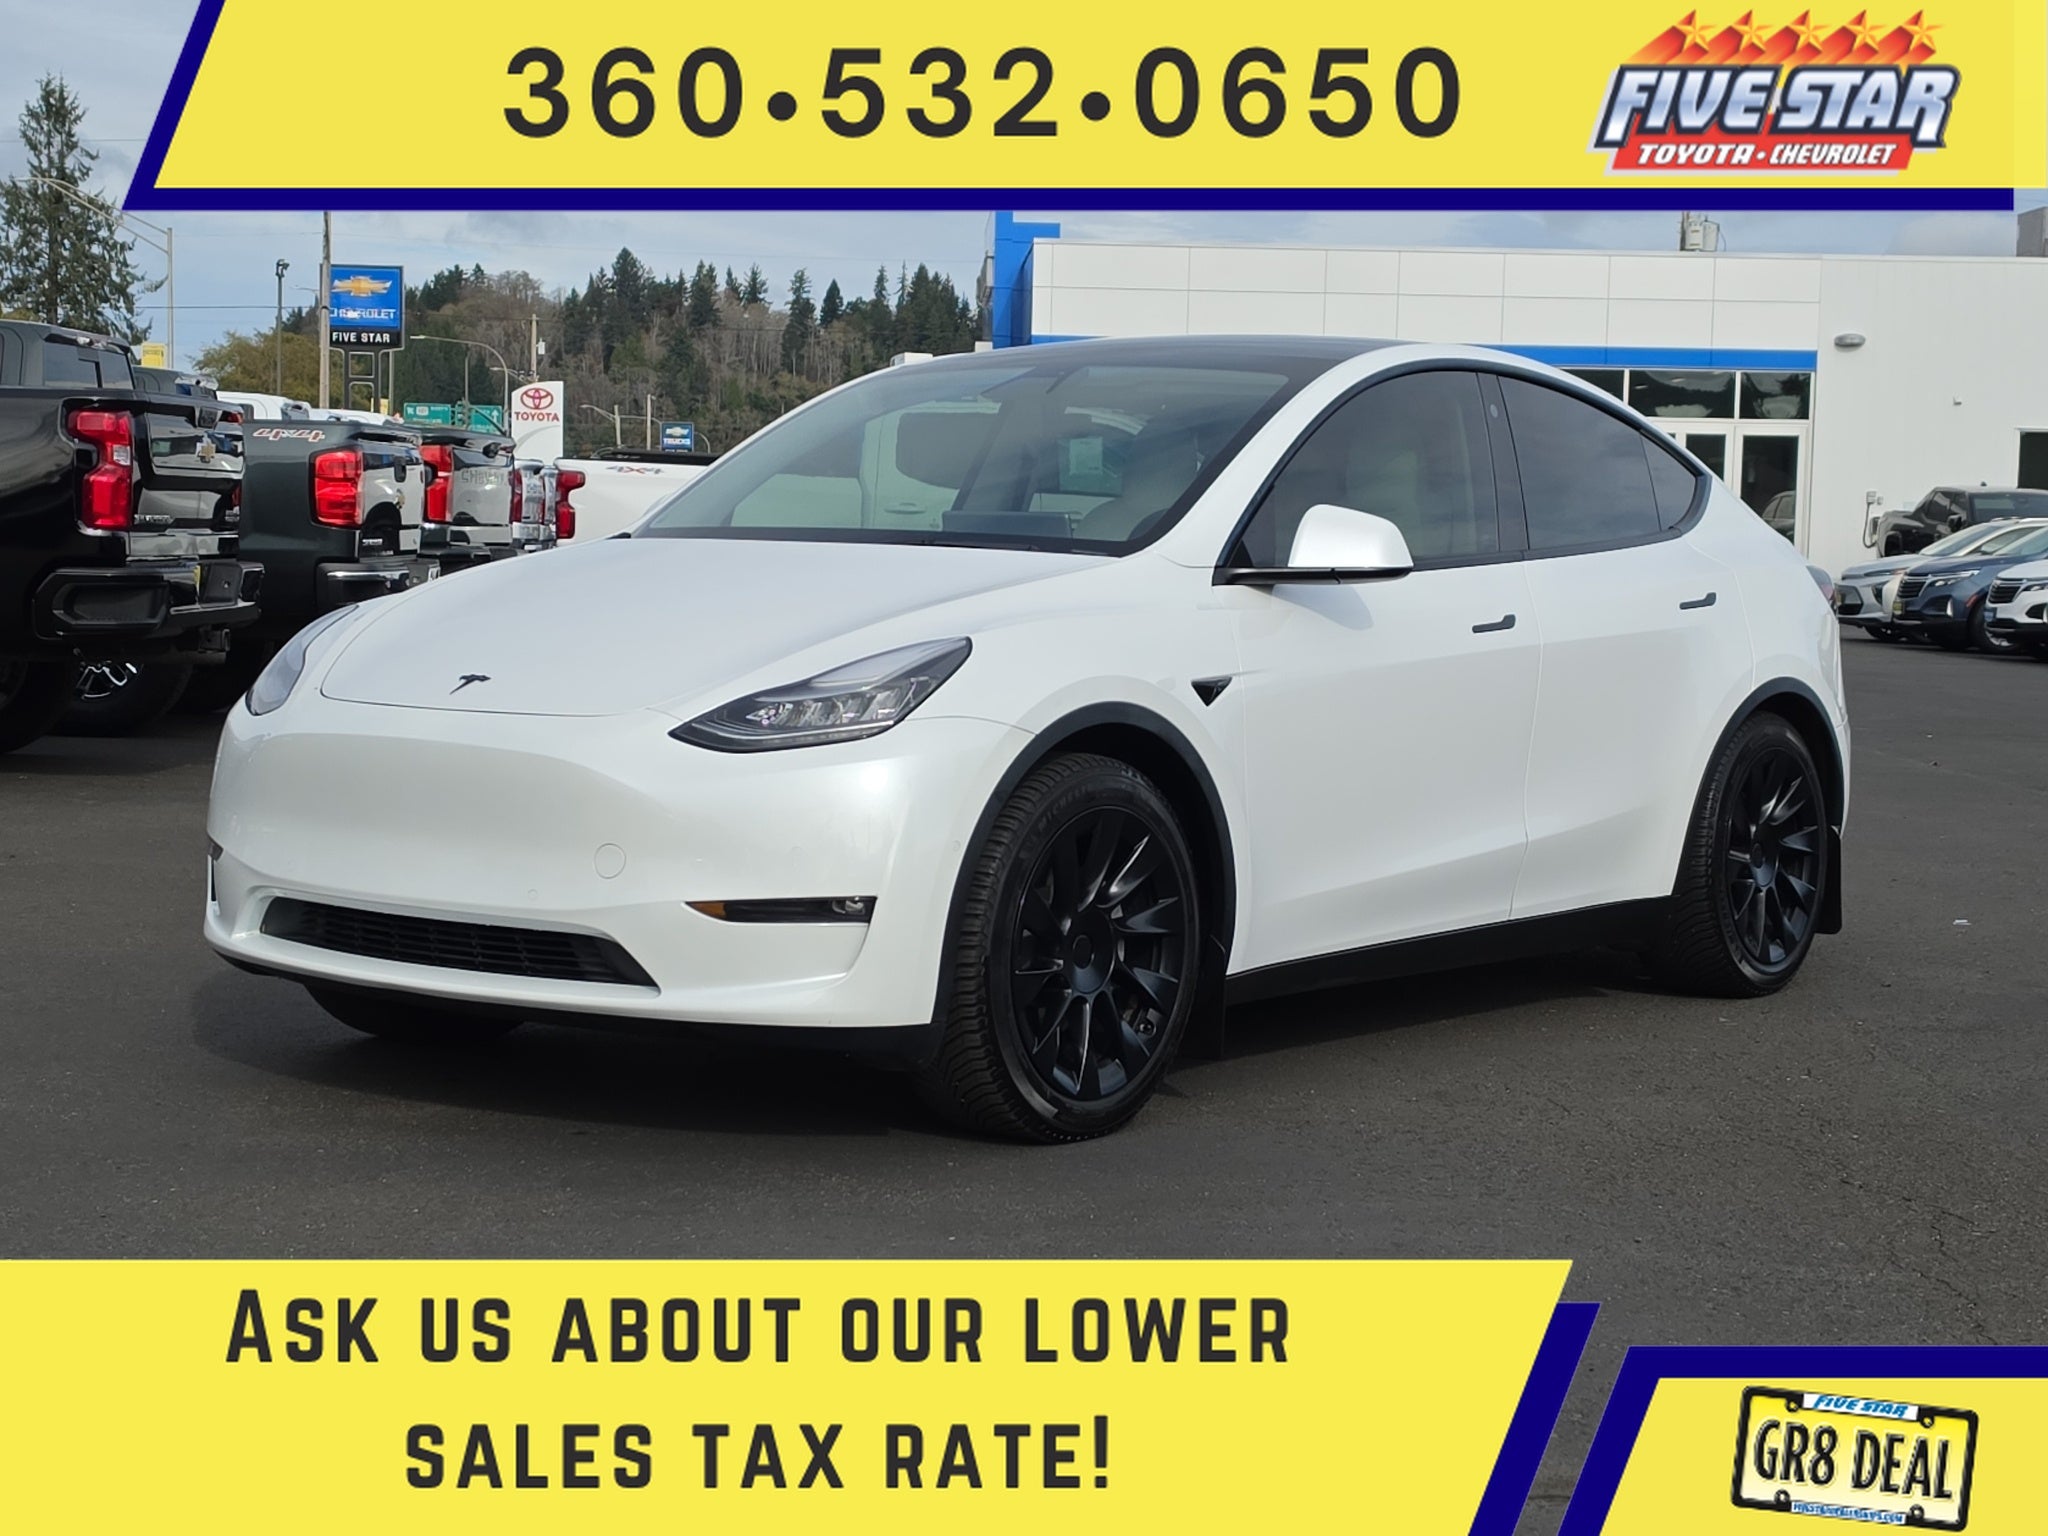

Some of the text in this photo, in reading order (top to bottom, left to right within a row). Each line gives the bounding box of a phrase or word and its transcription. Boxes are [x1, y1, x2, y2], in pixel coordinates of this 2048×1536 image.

[332, 331, 390, 343] FIVE STAR
[514, 411, 560, 422] TOYOTA
